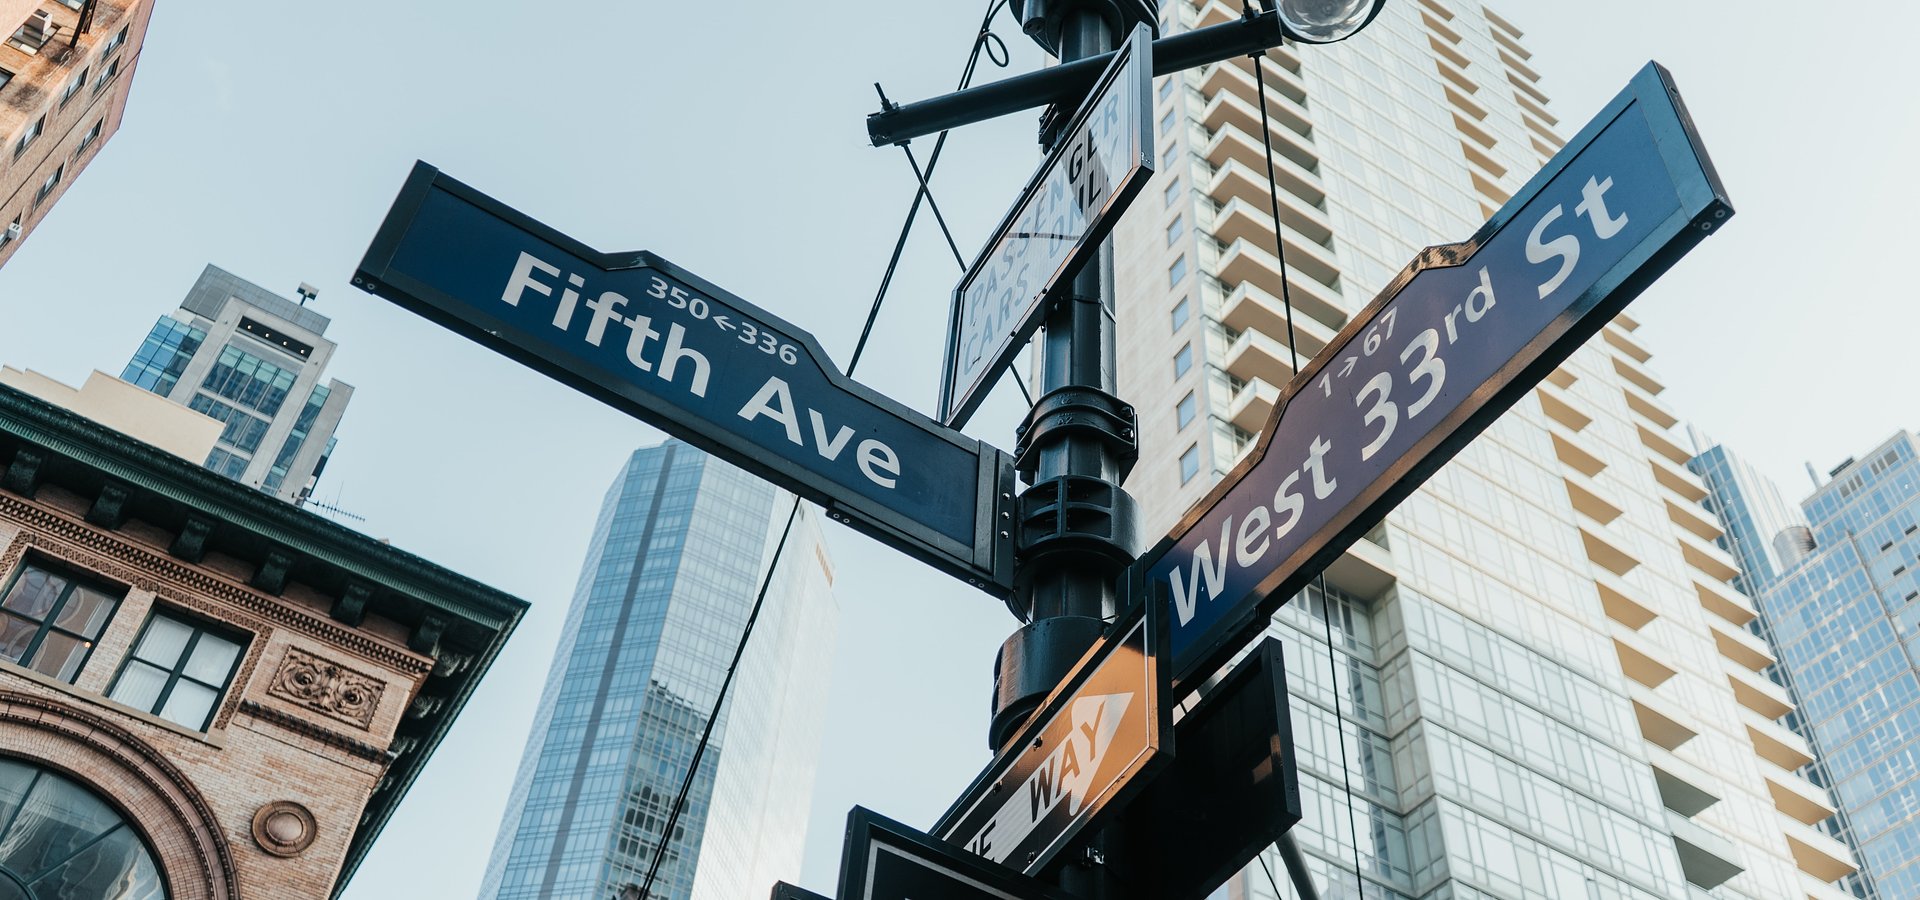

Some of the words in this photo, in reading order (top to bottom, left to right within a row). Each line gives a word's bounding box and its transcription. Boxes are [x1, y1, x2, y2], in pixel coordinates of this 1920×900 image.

[646, 276, 710, 320] 350
[737, 321, 798, 366] 336
[964, 263, 1030, 375] CARS
[1049, 135, 1118, 259] ONLY
[969, 93, 1118, 326] PASSENGER
[501, 250, 712, 398] Fifth
[737, 376, 902, 489] Ave
[1168, 434, 1338, 627] West
[1355, 266, 1497, 461] 33rd
[1524, 174, 1630, 299] St
[1318, 372, 1332, 398] 1
[1363, 306, 1398, 357] 67
[1030, 700, 1106, 823] WAY
